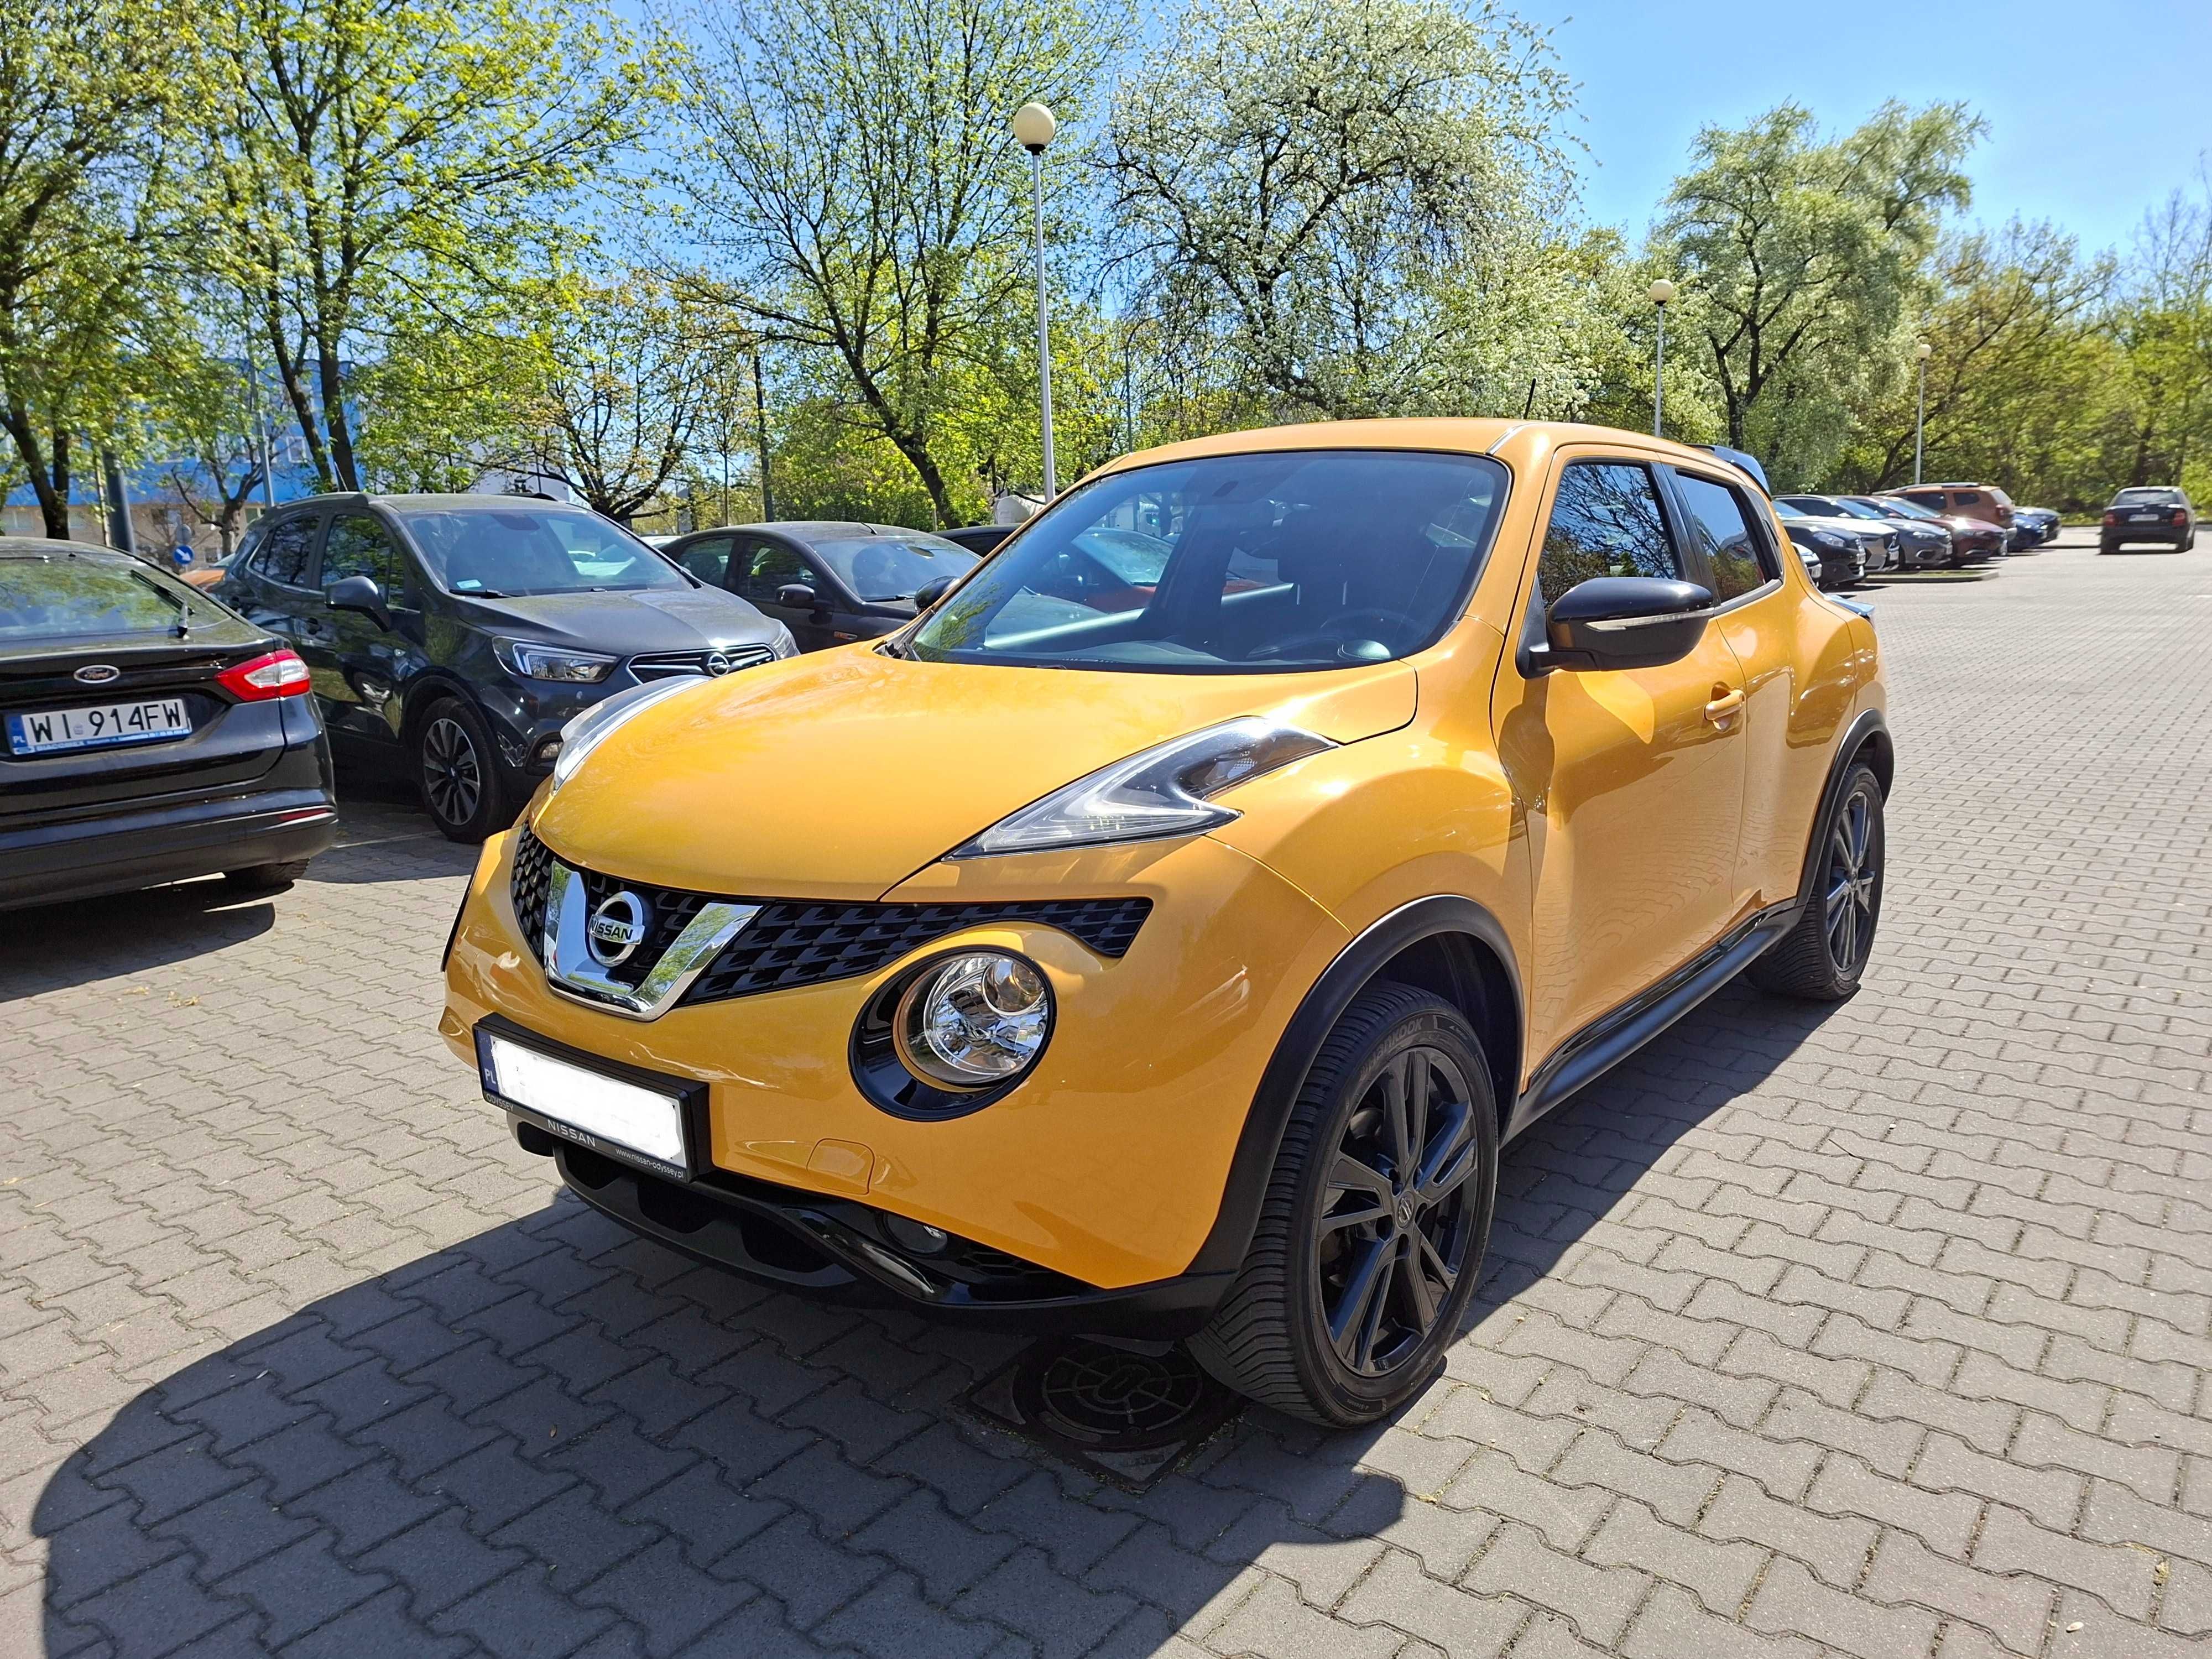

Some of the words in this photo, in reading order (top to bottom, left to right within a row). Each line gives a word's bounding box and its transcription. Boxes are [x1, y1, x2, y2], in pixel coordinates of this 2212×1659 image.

[88, 702, 181, 736] 914FW
[589, 917, 634, 940] NISSAN
[484, 1068, 496, 1084] PL
[487, 1093, 513, 1112] ODYSSEY
[547, 1119, 595, 1147] NISSAN
[615, 1148, 684, 1178] www.nissan-odyssey.pl
